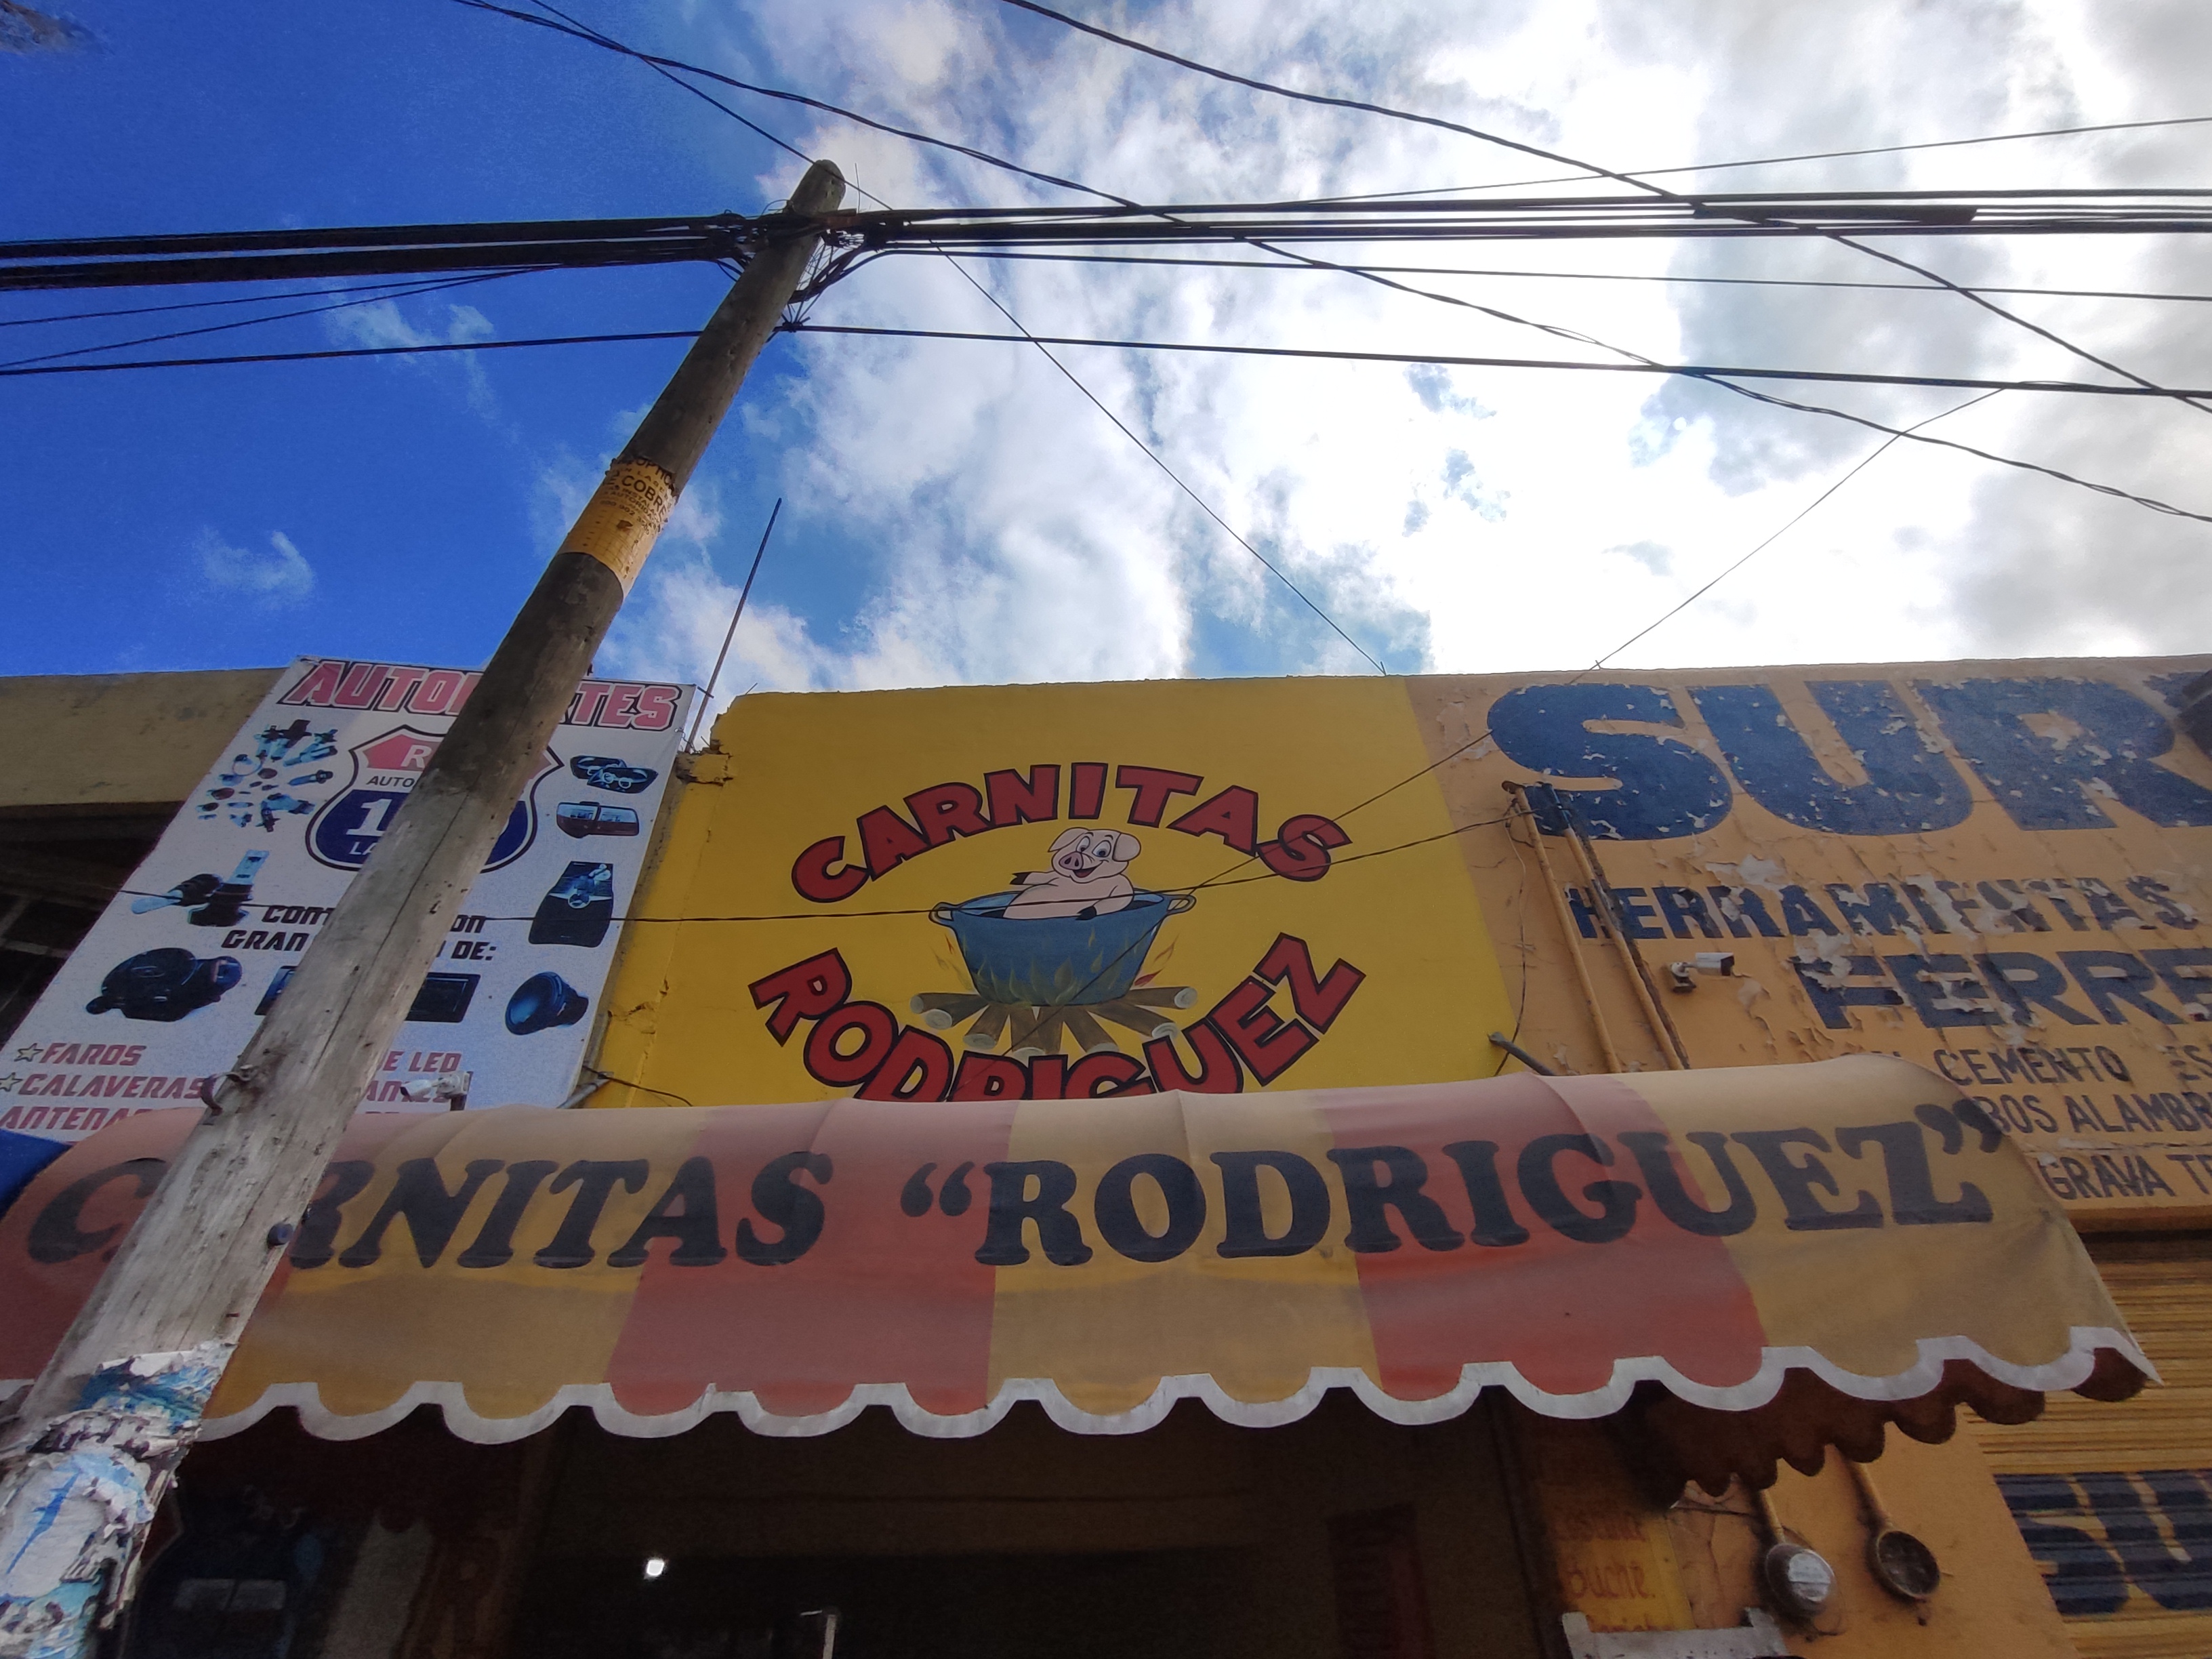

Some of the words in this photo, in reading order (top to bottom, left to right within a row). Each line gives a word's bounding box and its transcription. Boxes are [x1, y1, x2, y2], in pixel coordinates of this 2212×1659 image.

[621, 475, 667, 522] COBRE
[792, 762, 1353, 903] CARNITAS
[222, 930, 310, 951] GRAN
[39, 1042, 146, 1066] FAROS
[409, 1052, 462, 1072] LED
[1933, 1044, 2131, 1086] CEMENTO
[18, 1073, 206, 1099] CALAVERAS
[0, 1106, 154, 1130] ANTENA
[2064, 1091, 2212, 1133] ALAMBR
[2036, 1153, 2176, 1200] GRAVA
[27, 1150, 834, 1270] CRNITAS
